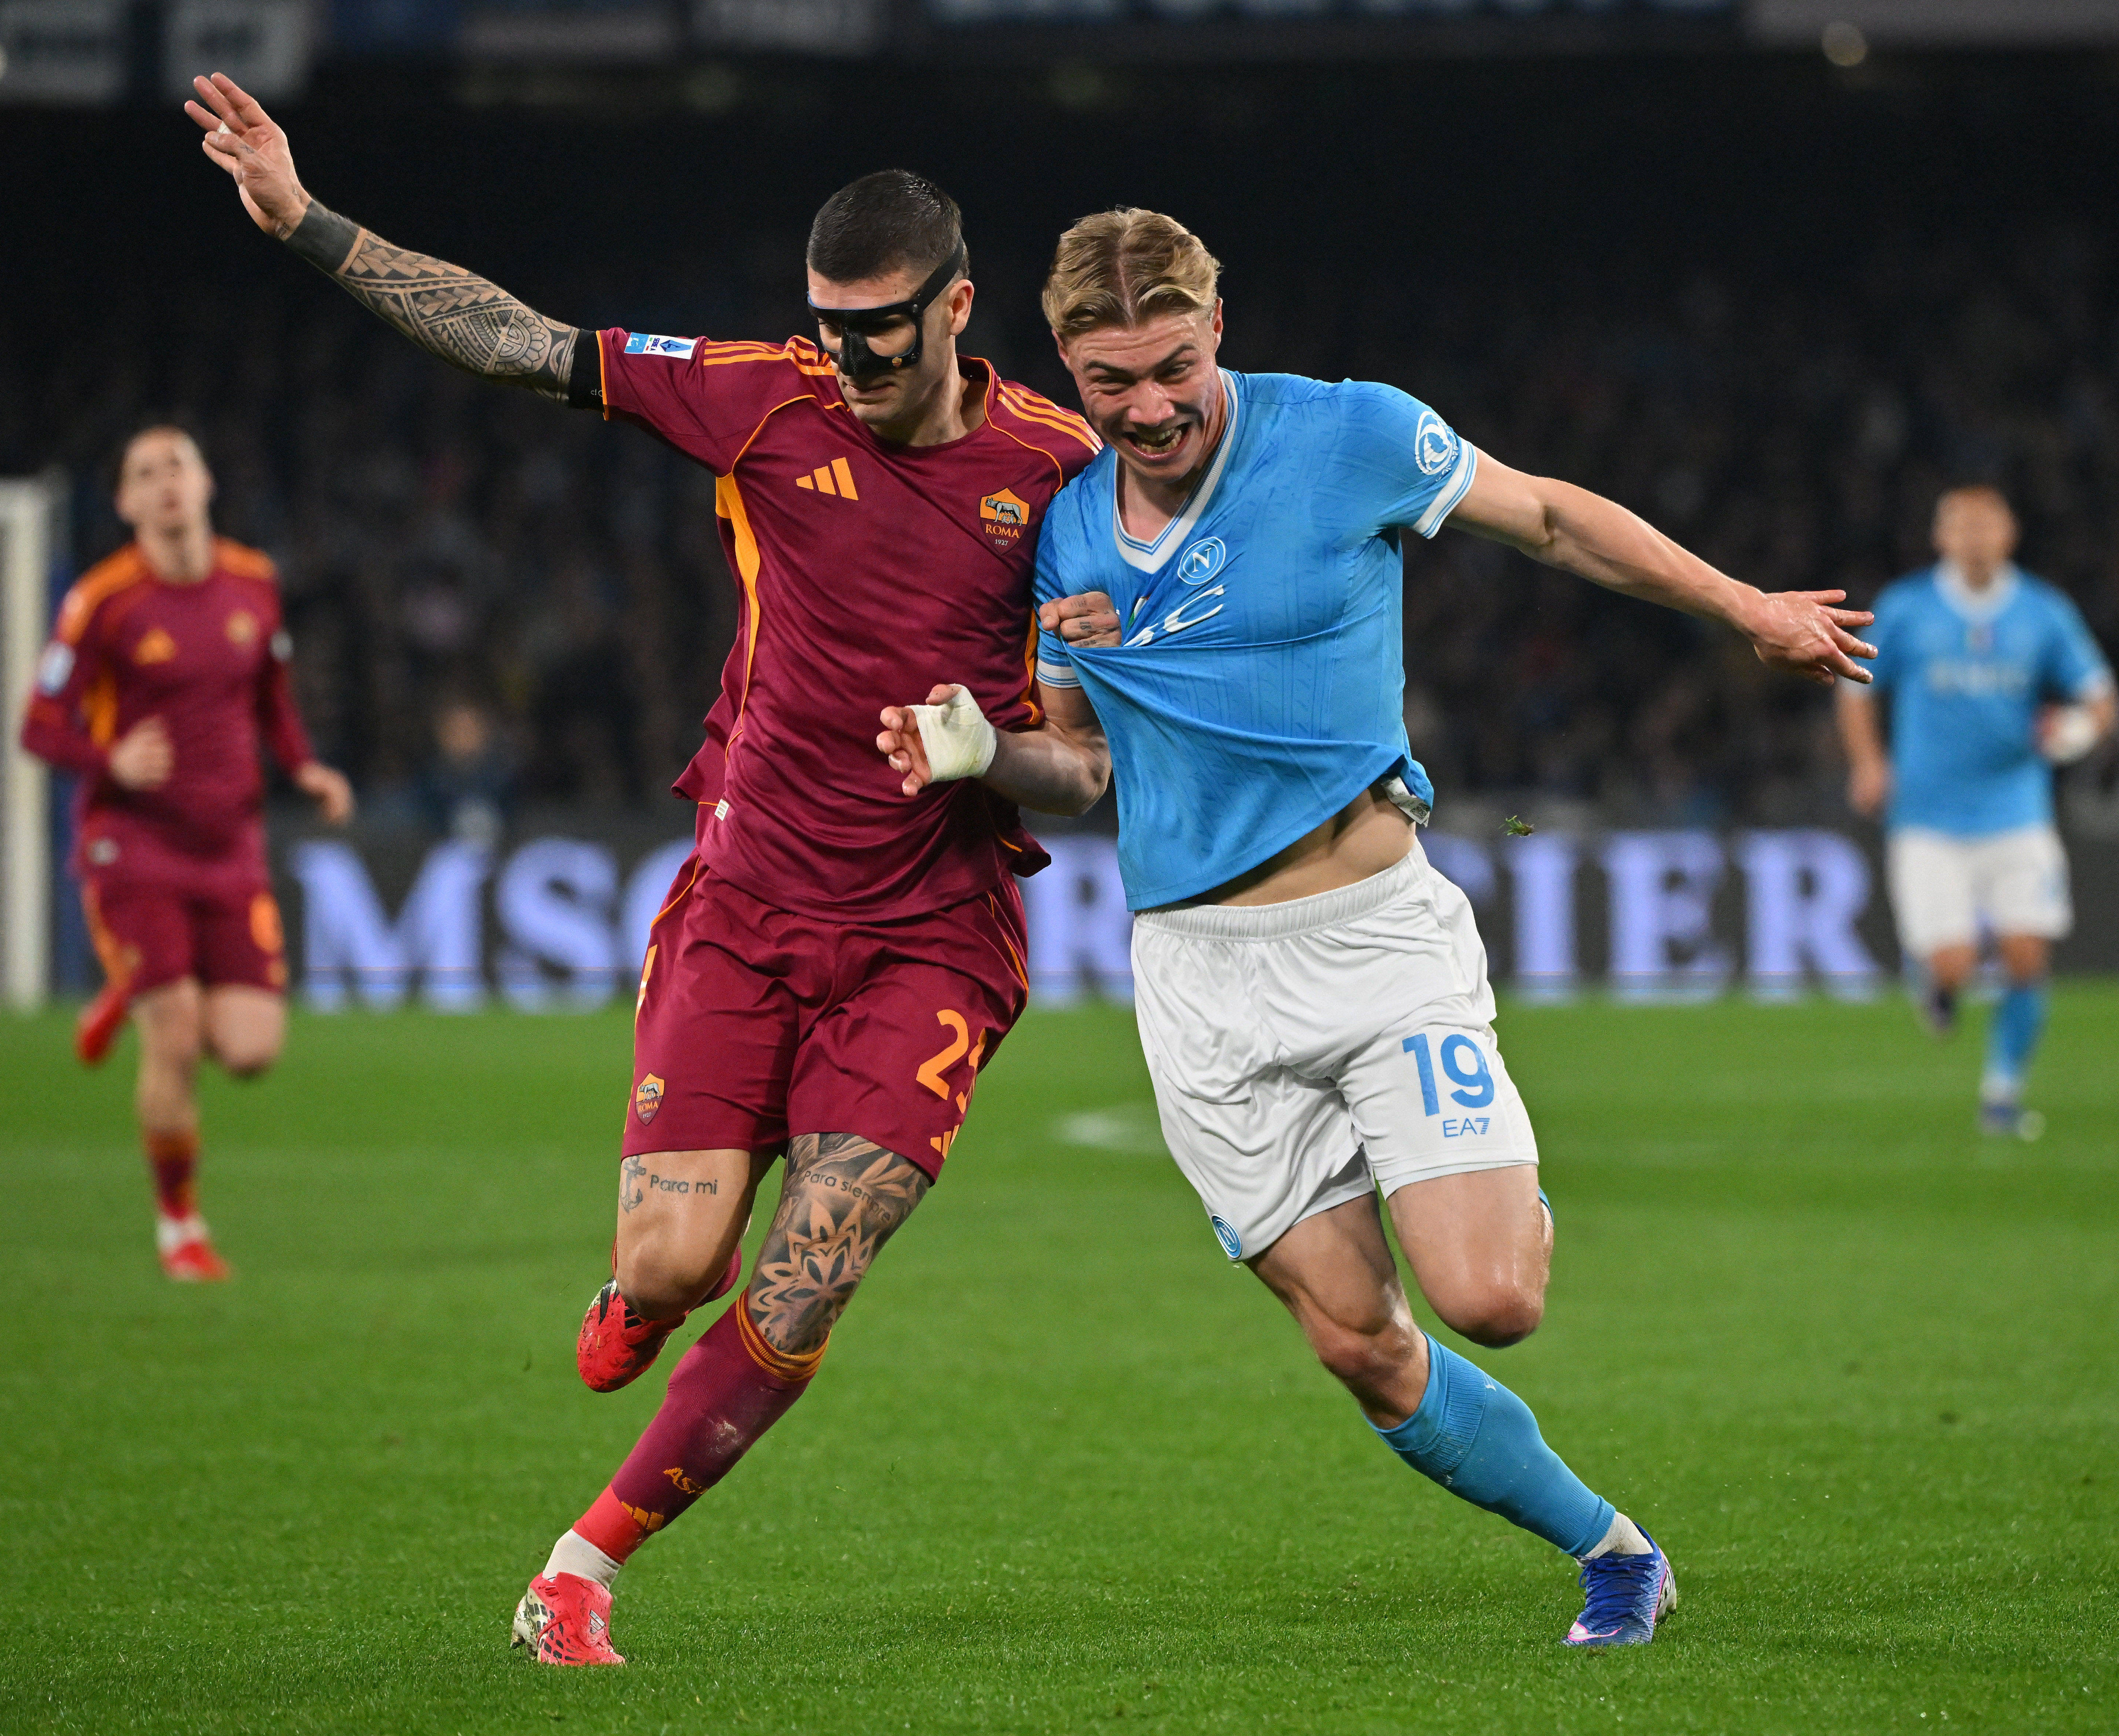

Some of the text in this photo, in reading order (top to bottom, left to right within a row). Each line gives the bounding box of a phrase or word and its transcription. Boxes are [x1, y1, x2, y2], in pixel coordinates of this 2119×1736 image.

[985, 524, 1020, 538] ROMA
[1190, 547, 1212, 573] N
[1402, 1033, 1495, 1117] 19
[637, 1101, 659, 1112] ROMA
[1442, 1117, 1490, 1138] EA7
[650, 1174, 718, 1195] Para mi
[802, 1170, 837, 1187] Para
